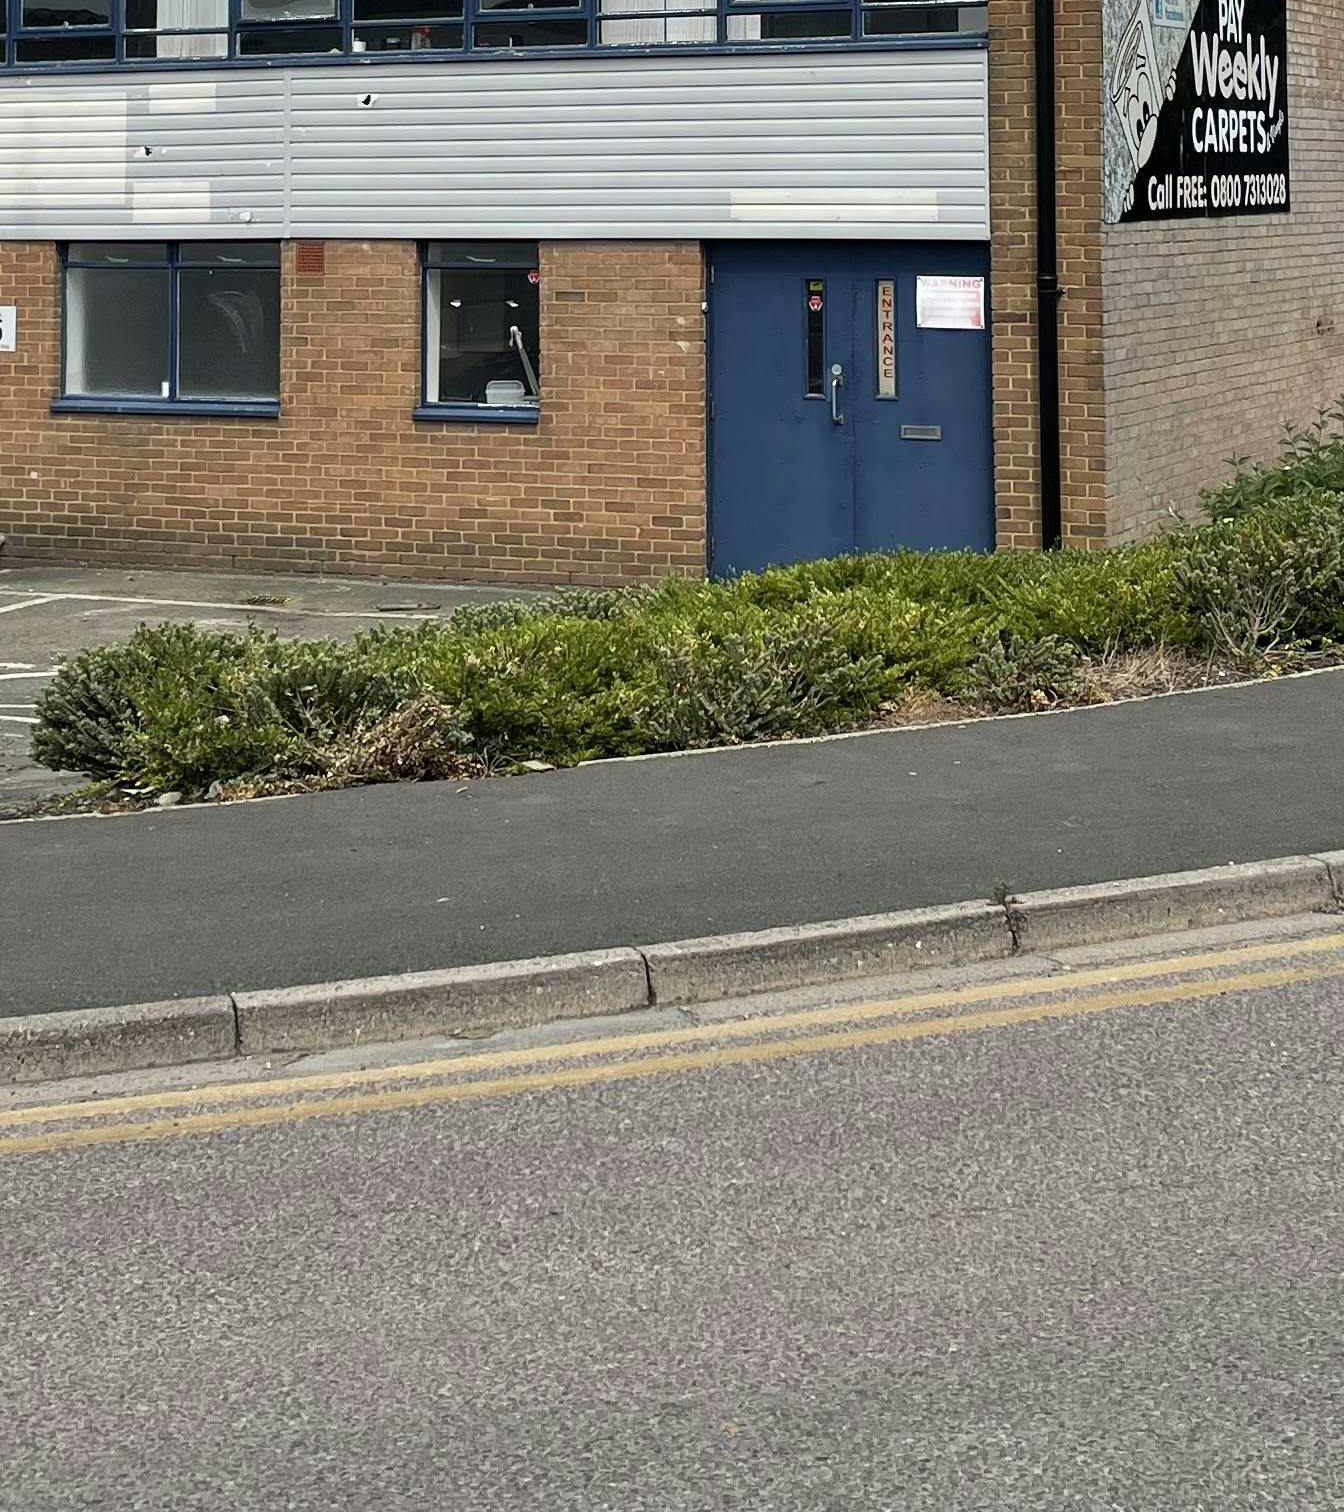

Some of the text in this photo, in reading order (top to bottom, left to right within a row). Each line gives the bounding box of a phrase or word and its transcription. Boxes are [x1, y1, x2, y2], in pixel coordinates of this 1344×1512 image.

[1190, 29, 1279, 118] Weekly
[1191, 106, 1267, 154] CARPETS
[1147, 173, 1287, 211] Call FREE: 0800 7313028
[920, 277, 982, 289] WARNING
[882, 286, 894, 379] ENTRANCE
